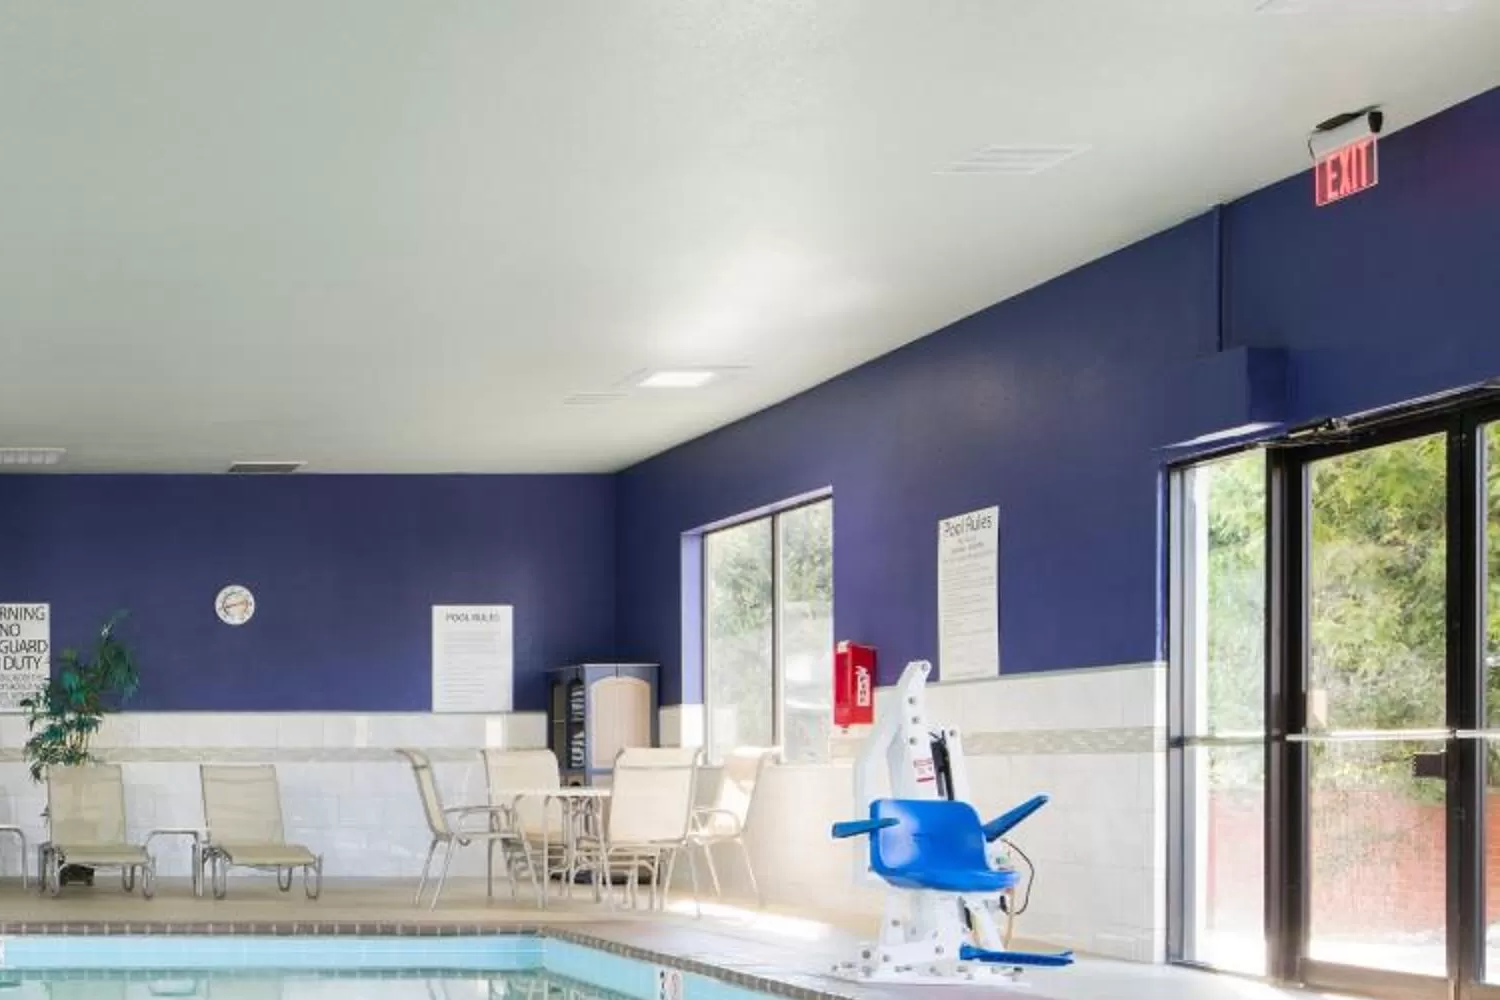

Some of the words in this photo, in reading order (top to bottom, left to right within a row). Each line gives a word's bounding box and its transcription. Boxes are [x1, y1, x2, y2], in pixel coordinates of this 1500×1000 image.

[1326, 139, 1373, 200] EXIT
[966, 514, 993, 534] Rules
[0, 623, 21, 637] NO
[3, 656, 43, 671] DUTY
